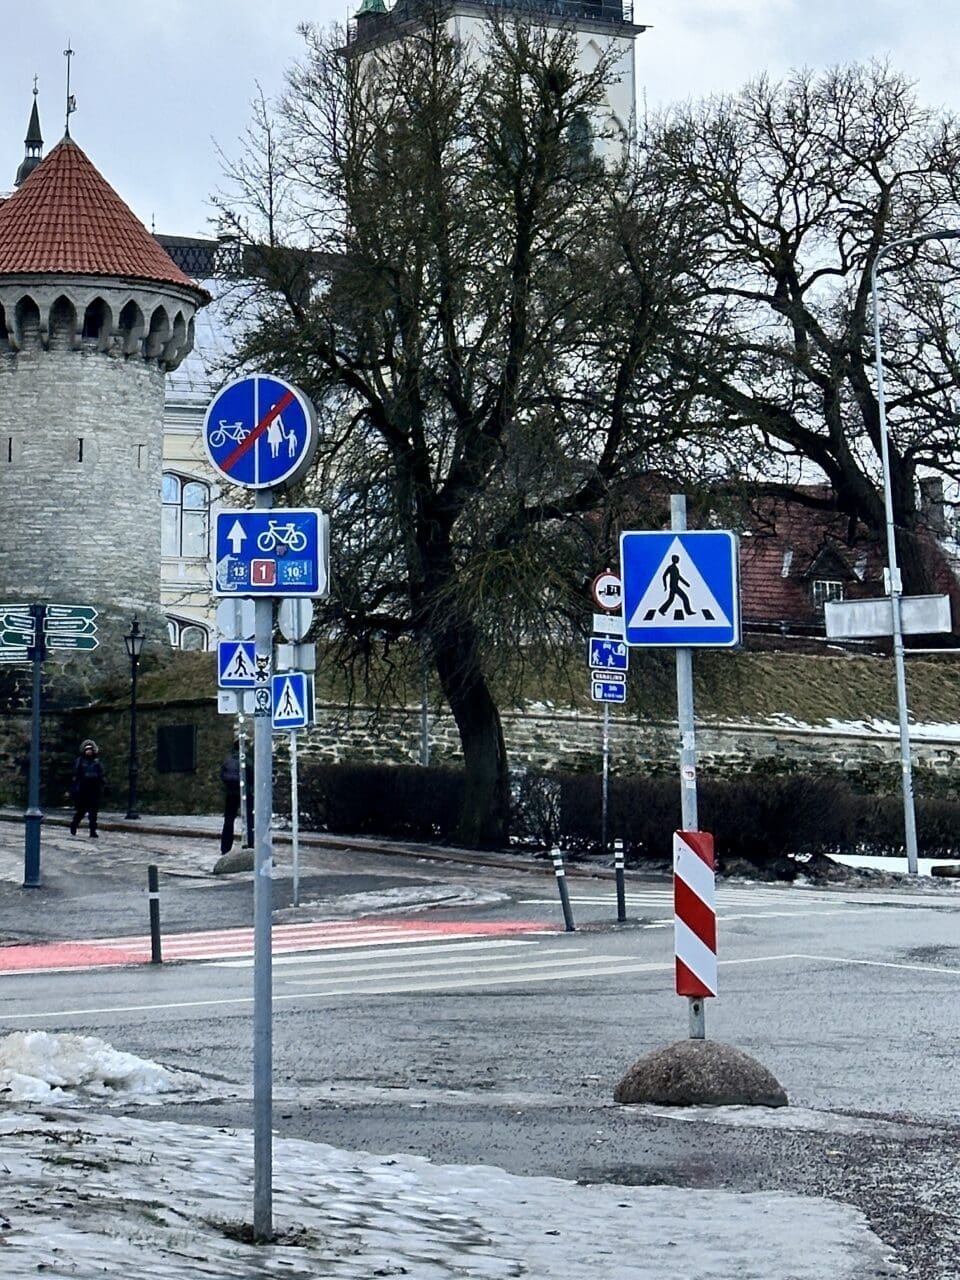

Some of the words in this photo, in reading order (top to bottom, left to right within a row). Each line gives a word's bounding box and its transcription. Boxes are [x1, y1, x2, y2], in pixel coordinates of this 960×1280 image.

[234, 567, 245, 577] 13
[259, 565, 266, 580] 1
[287, 567, 299, 577] 10
